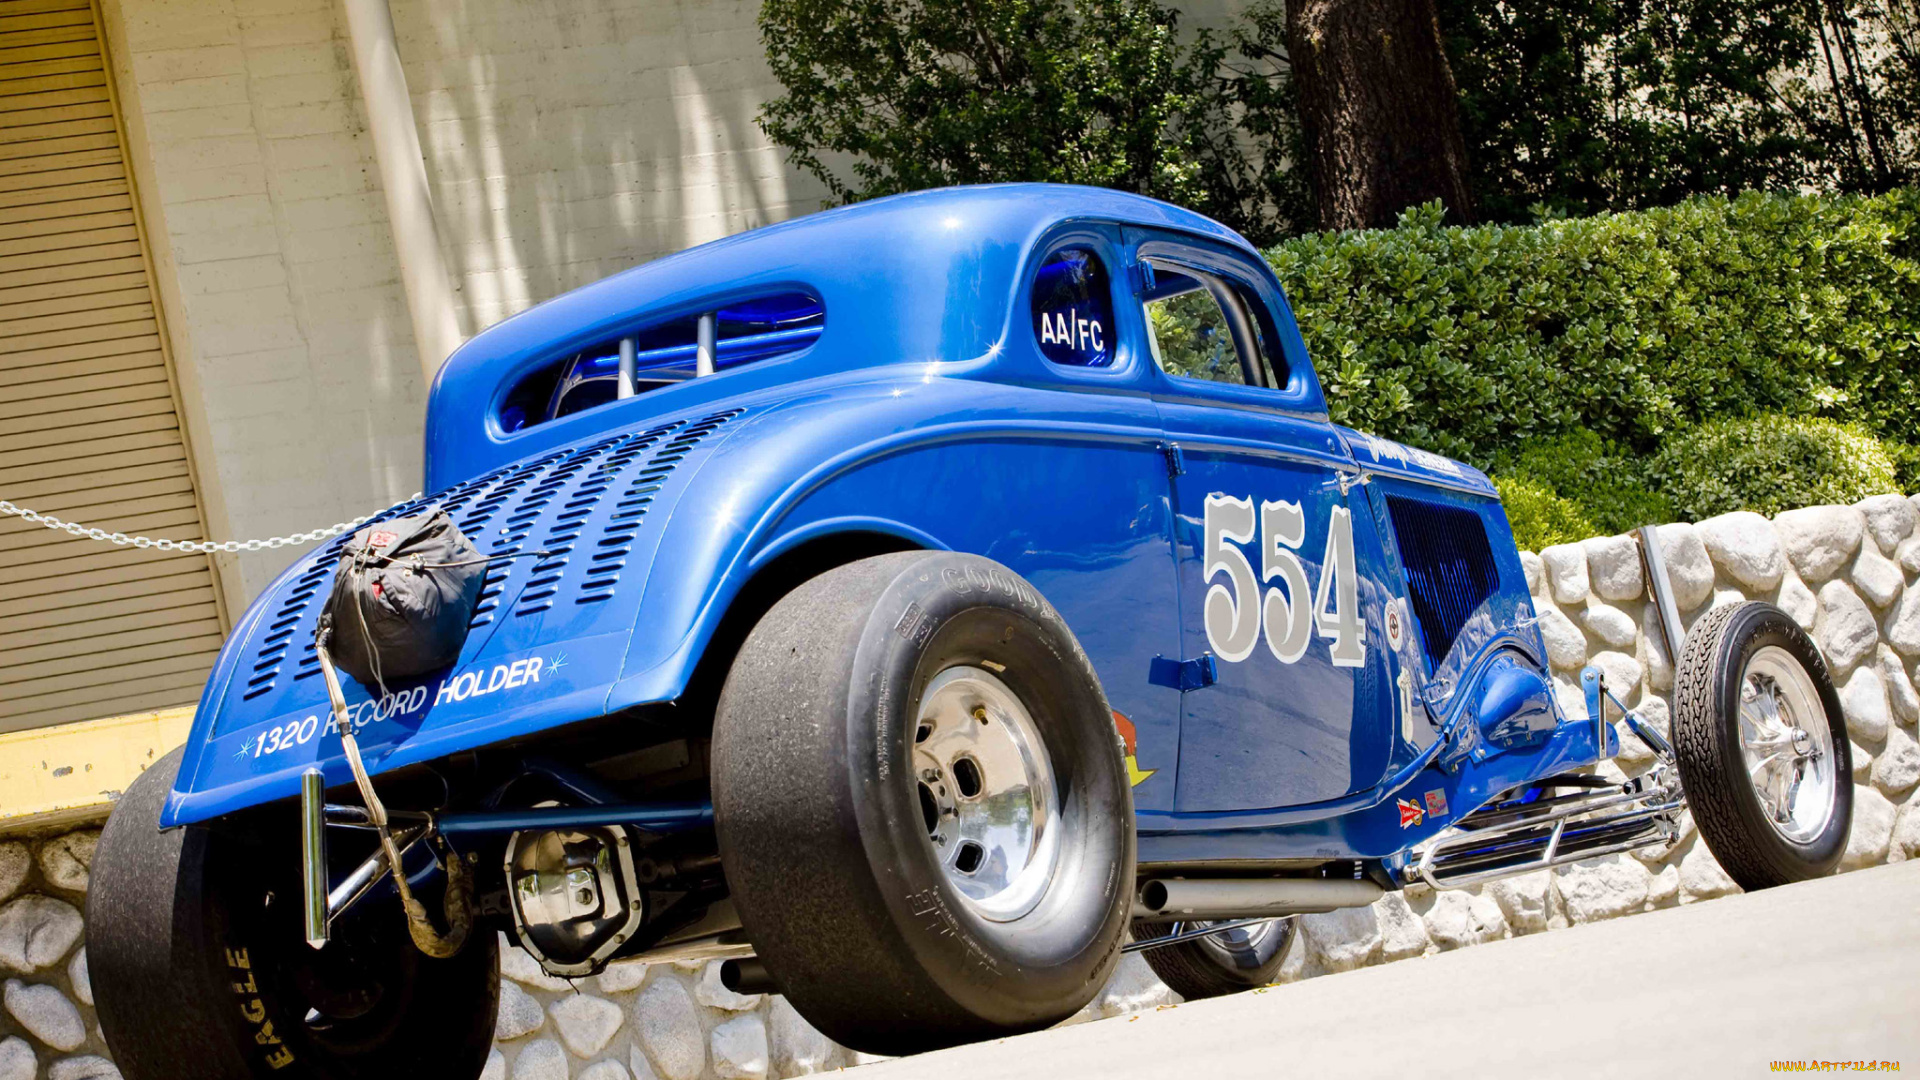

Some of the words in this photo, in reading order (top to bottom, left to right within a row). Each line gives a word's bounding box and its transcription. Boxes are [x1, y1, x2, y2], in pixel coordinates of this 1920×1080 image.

[1041, 308, 1104, 352] AA/FC
[1203, 492, 1366, 668] 554
[253, 715, 319, 758] 1320
[433, 656, 544, 708] HOLDER
[225, 947, 295, 1070] EAGLE
